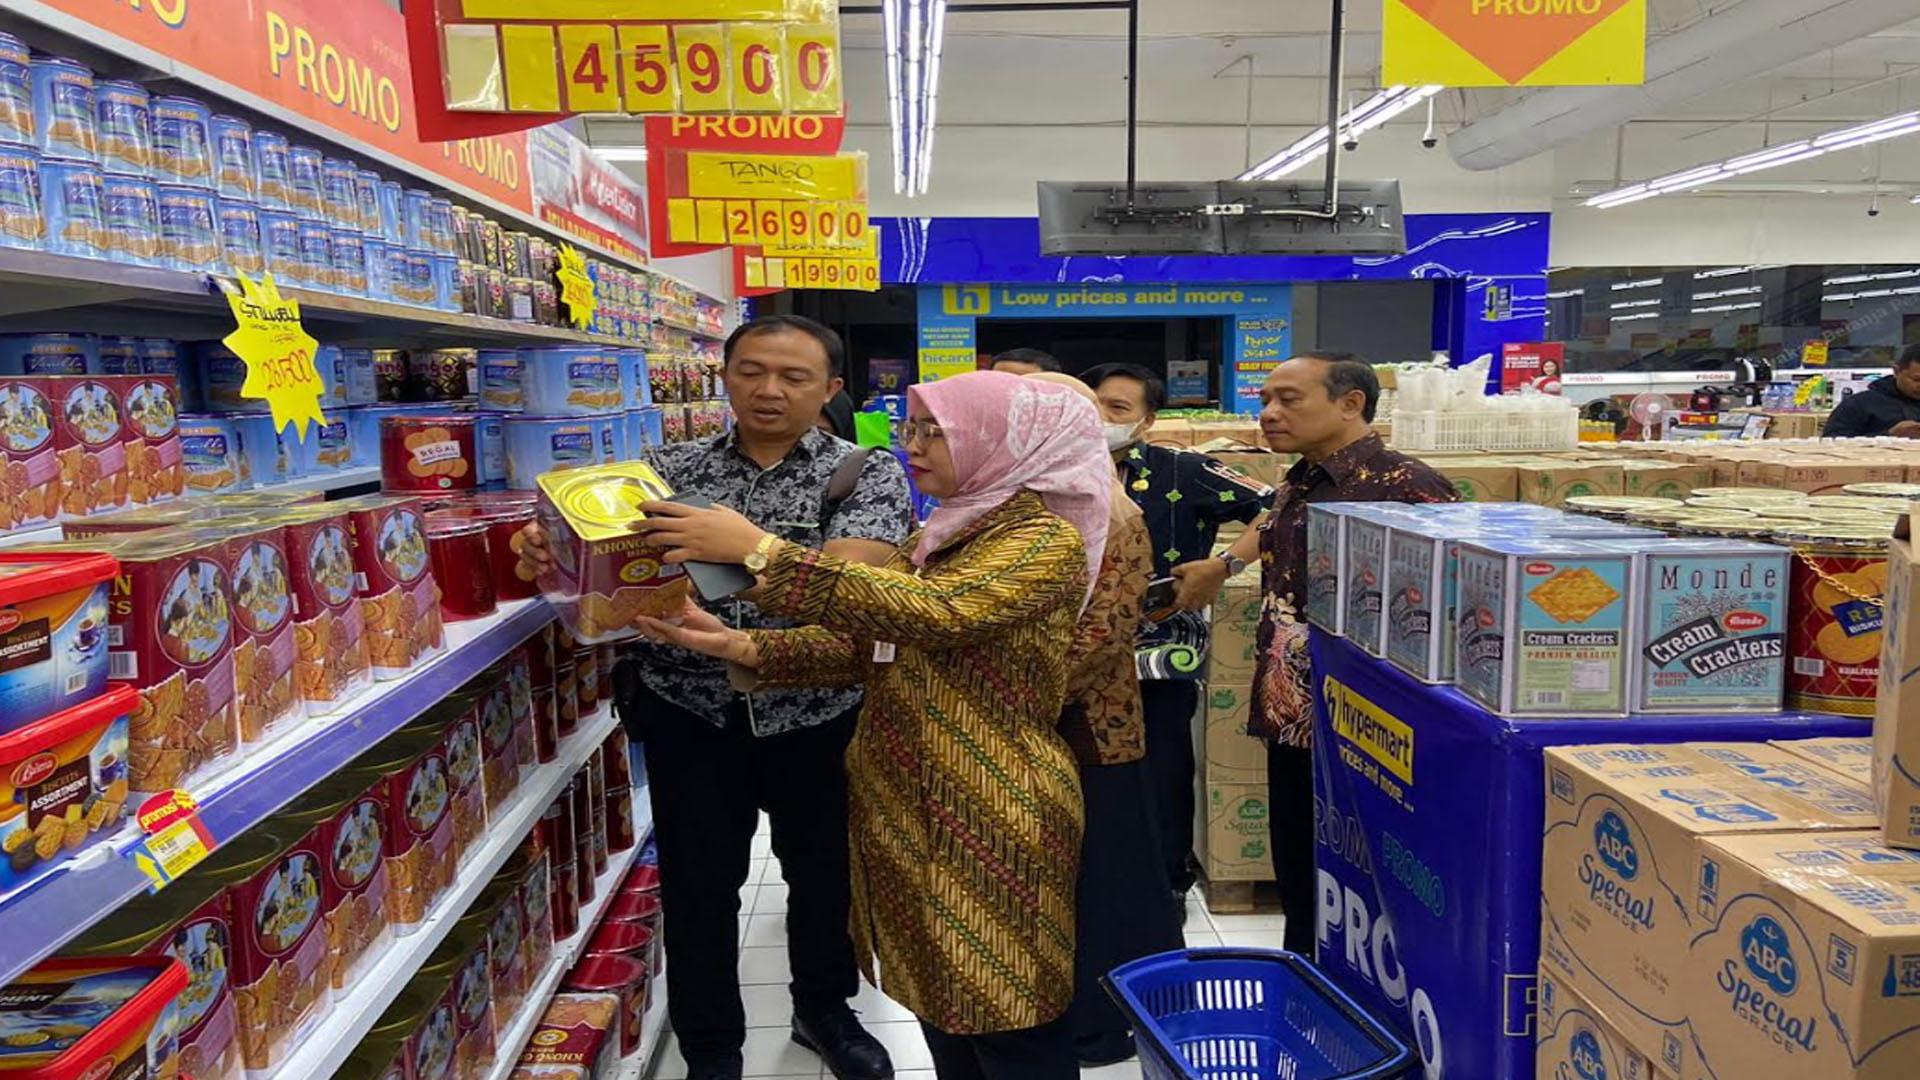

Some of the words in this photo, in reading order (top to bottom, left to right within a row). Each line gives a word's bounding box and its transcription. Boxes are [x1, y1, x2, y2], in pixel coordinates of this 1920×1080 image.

[1471, 0, 1603, 16] PROMO
[265, 10, 402, 134] PROMO
[572, 42, 828, 95] 45900
[671, 115, 824, 139] PROMO
[732, 209, 863, 238] 26900
[790, 265, 877, 282] 19900
[1001, 289, 1048, 305] Low
[1056, 289, 1127, 309] prices
[1134, 289, 1178, 305] and
[1184, 290, 1243, 304] more
[420, 444, 456, 457] REGAL
[593, 538, 647, 556] KHONG
[1660, 562, 1777, 590] Monde
[1528, 632, 1565, 645] Cream
[1567, 631, 1615, 645] Crackers
[1650, 623, 1718, 664] Cream
[1689, 638, 1783, 677] Crackers
[1342, 690, 1409, 770] hypermart
[30, 776, 89, 812] ASSORTMENT
[1599, 832, 1635, 870] ABC
[1382, 830, 1445, 918] PROMO
[1577, 854, 1655, 930] Special
[1594, 895, 1639, 933] GRADE
[1745, 937, 1792, 985] ABC
[1835, 951, 1847, 970] 5
[1716, 958, 1817, 1053] Special
[1737, 1006, 1794, 1054] GRADE
